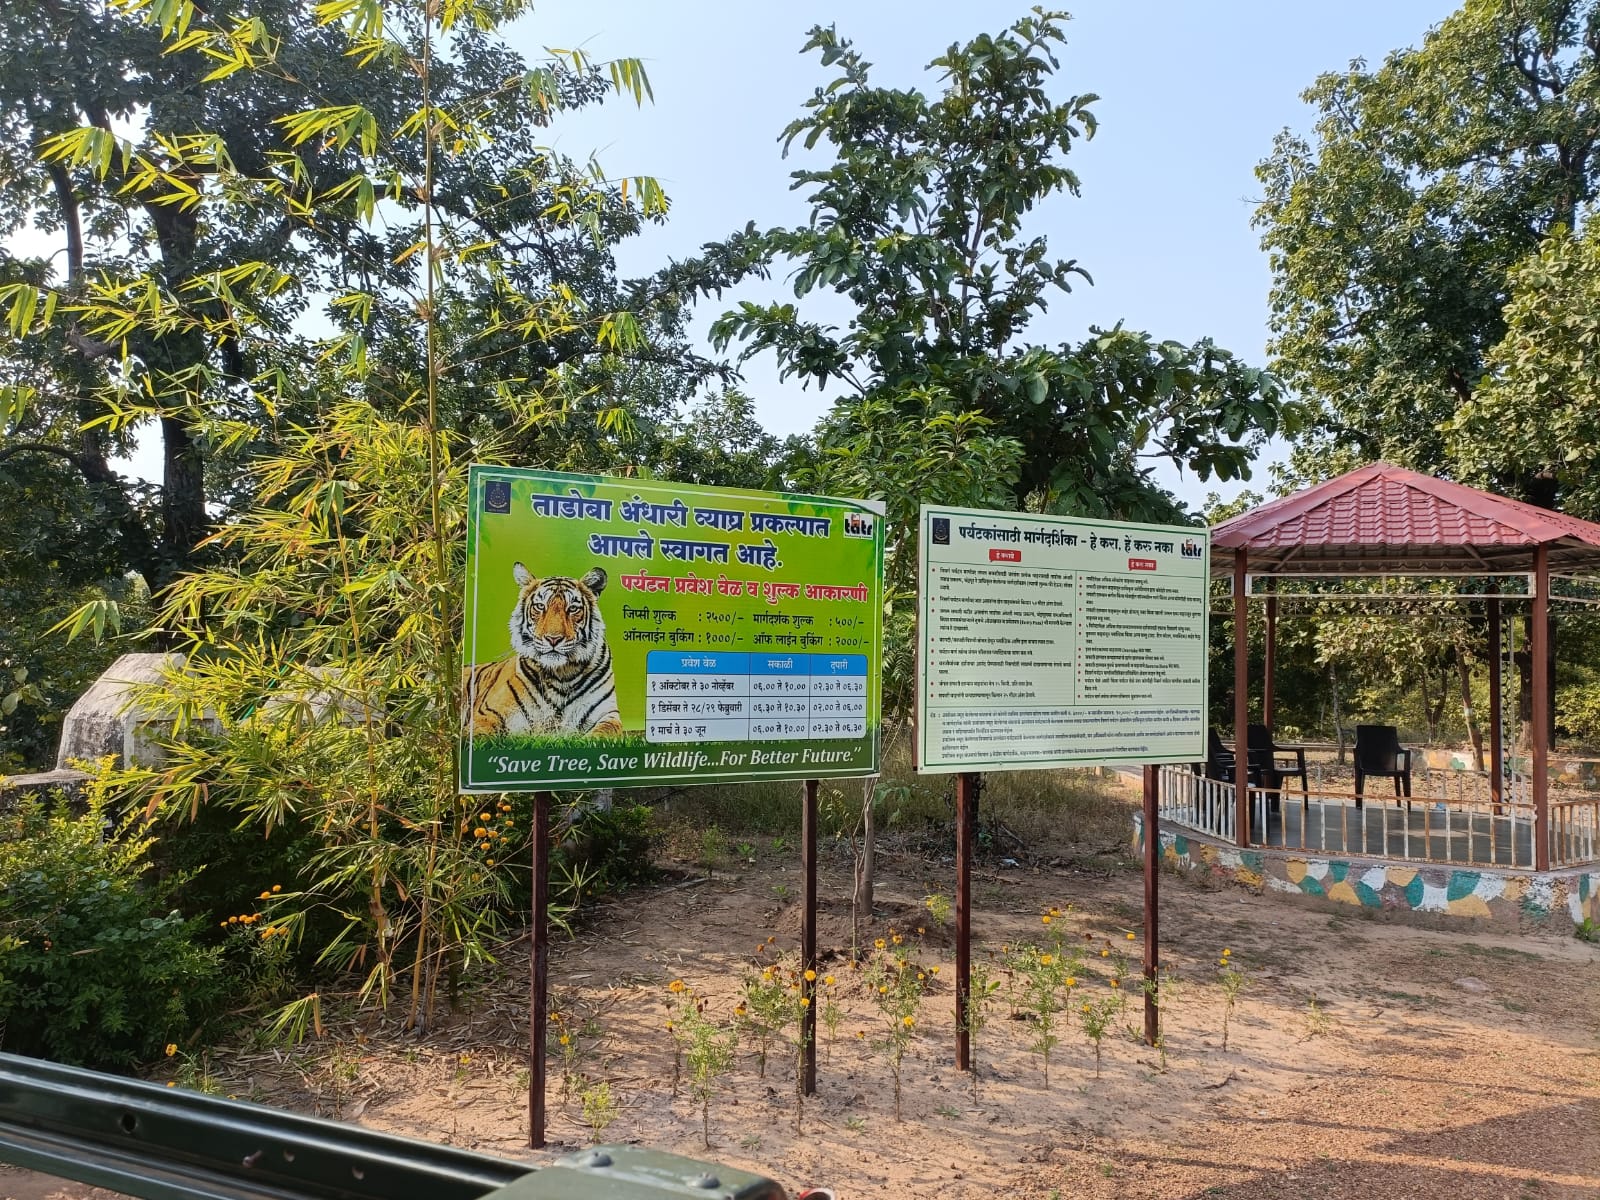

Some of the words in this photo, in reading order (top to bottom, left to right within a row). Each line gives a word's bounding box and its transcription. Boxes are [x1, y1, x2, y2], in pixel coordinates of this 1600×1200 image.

[531, 488, 613, 522] ताडोबा
[619, 493, 688, 528] अंधारी
[693, 506, 745, 533] व्याघ्र
[750, 511, 832, 538] प्रकल्पात
[959, 522, 1021, 543] पर्यटकांसाठी
[1024, 528, 1078, 547] मार्गदर्शिका
[1090, 531, 1098, 550] हे
[1154, 541, 1174, 554] नका
[588, 529, 655, 560] आपले
[659, 538, 730, 564] स्वागत
[736, 538, 783, 572] आहे.
[621, 569, 671, 593] पर्यटन
[674, 571, 714, 597] प्रवेश
[717, 573, 743, 597] वेळ
[746, 580, 760, 597] व
[763, 581, 801, 606] शुल्क
[805, 581, 868, 603] आकारणी
[623, 605, 649, 620] जिप्सी
[652, 609, 677, 624] शुल्क
[753, 610, 790, 626] मार्गदर्शक
[792, 615, 814, 629] शुल्क
[623, 628, 665, 644] ऑनलाईन
[669, 628, 695, 646] बुकिंग
[753, 632, 773, 645] ऑफ
[775, 632, 797, 648] लाईन
[800, 632, 823, 649] बुकिंग
[681, 655, 700, 668] प्रवेश
[703, 655, 717, 668] वेळ
[767, 657, 793, 669] सकाळी
[830, 658, 848, 674] दुपारी
[652, 681, 656, 691] १
[659, 679, 690, 690] ऑक्टोबर
[691, 679, 697, 690] ते
[699, 682, 709, 692] ३०
[777, 680, 782, 690] ते
[835, 680, 841, 690] ते
[651, 703, 656, 714] १
[658, 701, 681, 713] डिसेंबर
[683, 701, 689, 713] ते
[777, 700, 782, 712] ते
[835, 700, 841, 711] ते
[651, 726, 655, 736] १
[657, 723, 673, 735] मार्च
[674, 723, 680, 735] ते
[683, 726, 693, 736] ३०
[695, 725, 706, 738] जून
[776, 721, 782, 733] ते
[835, 720, 840, 732] ते
[547, 755, 592, 773] Tree,
[597, 753, 638, 770] Save
[750, 749, 799, 765] Better
